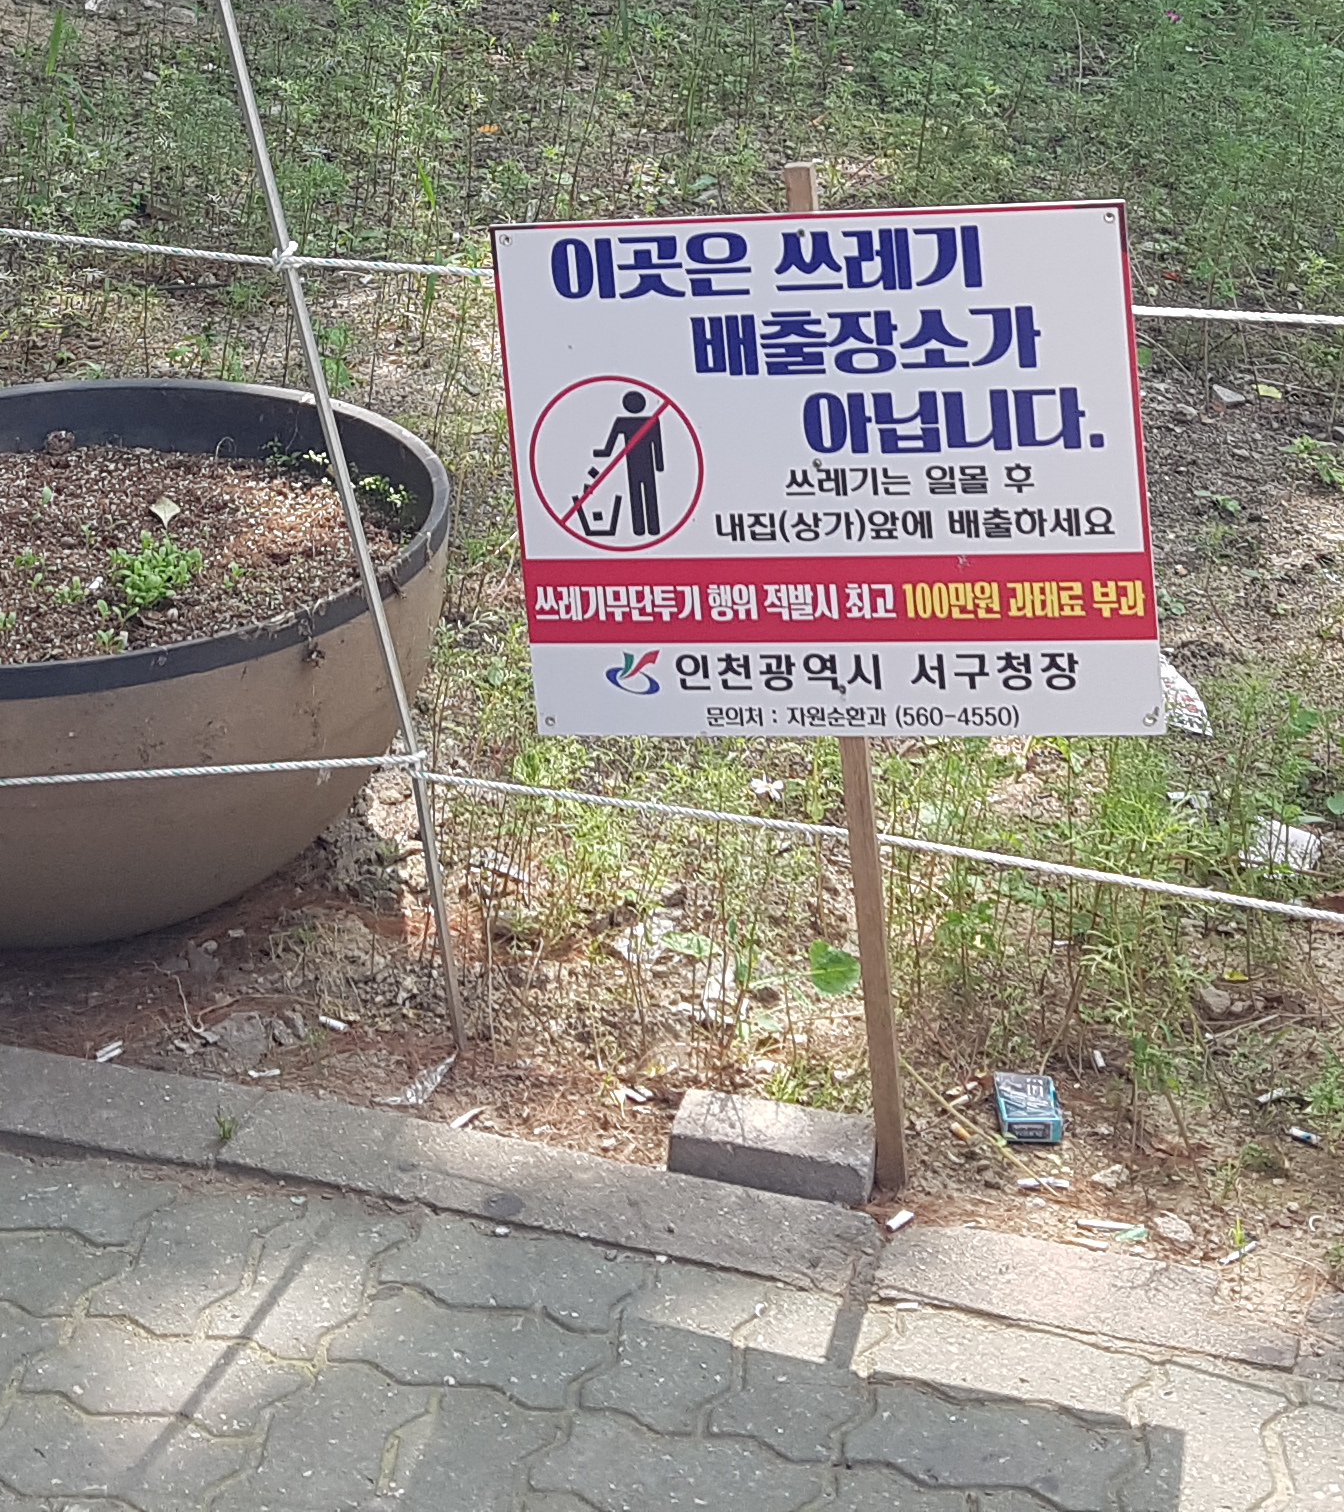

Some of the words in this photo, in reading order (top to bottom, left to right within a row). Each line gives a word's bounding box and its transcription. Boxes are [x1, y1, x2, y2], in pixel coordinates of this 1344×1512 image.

[551, 232, 751, 299] 이곳은
[775, 226, 982, 291] 쓰레기
[690, 306, 1041, 376] 배출장소가
[803, 388, 1104, 454] 아닙니다.
[786, 466, 910, 496] 쓰레기는
[926, 466, 988, 494] 일몰
[1005, 464, 1034, 493] 후
[716, 509, 933, 542] 내집(상가)앞에
[948, 507, 1115, 538] 배출하세요
[535, 585, 701, 621] 쓰레기무단투기
[708, 584, 758, 621] 행위
[763, 584, 839, 620] 적발시
[845, 584, 896, 619] 최고
[903, 582, 1001, 618] 100만원
[1007, 582, 1086, 617] 과태료
[1092, 580, 1145, 617] 부과
[676, 654, 881, 691] 인천광역시
[911, 652, 1078, 690] 서구청장
[707, 707, 763, 726] 문의처
[787, 707, 886, 727] 자원순환과
[896, 705, 1019, 728] (560-4550)
